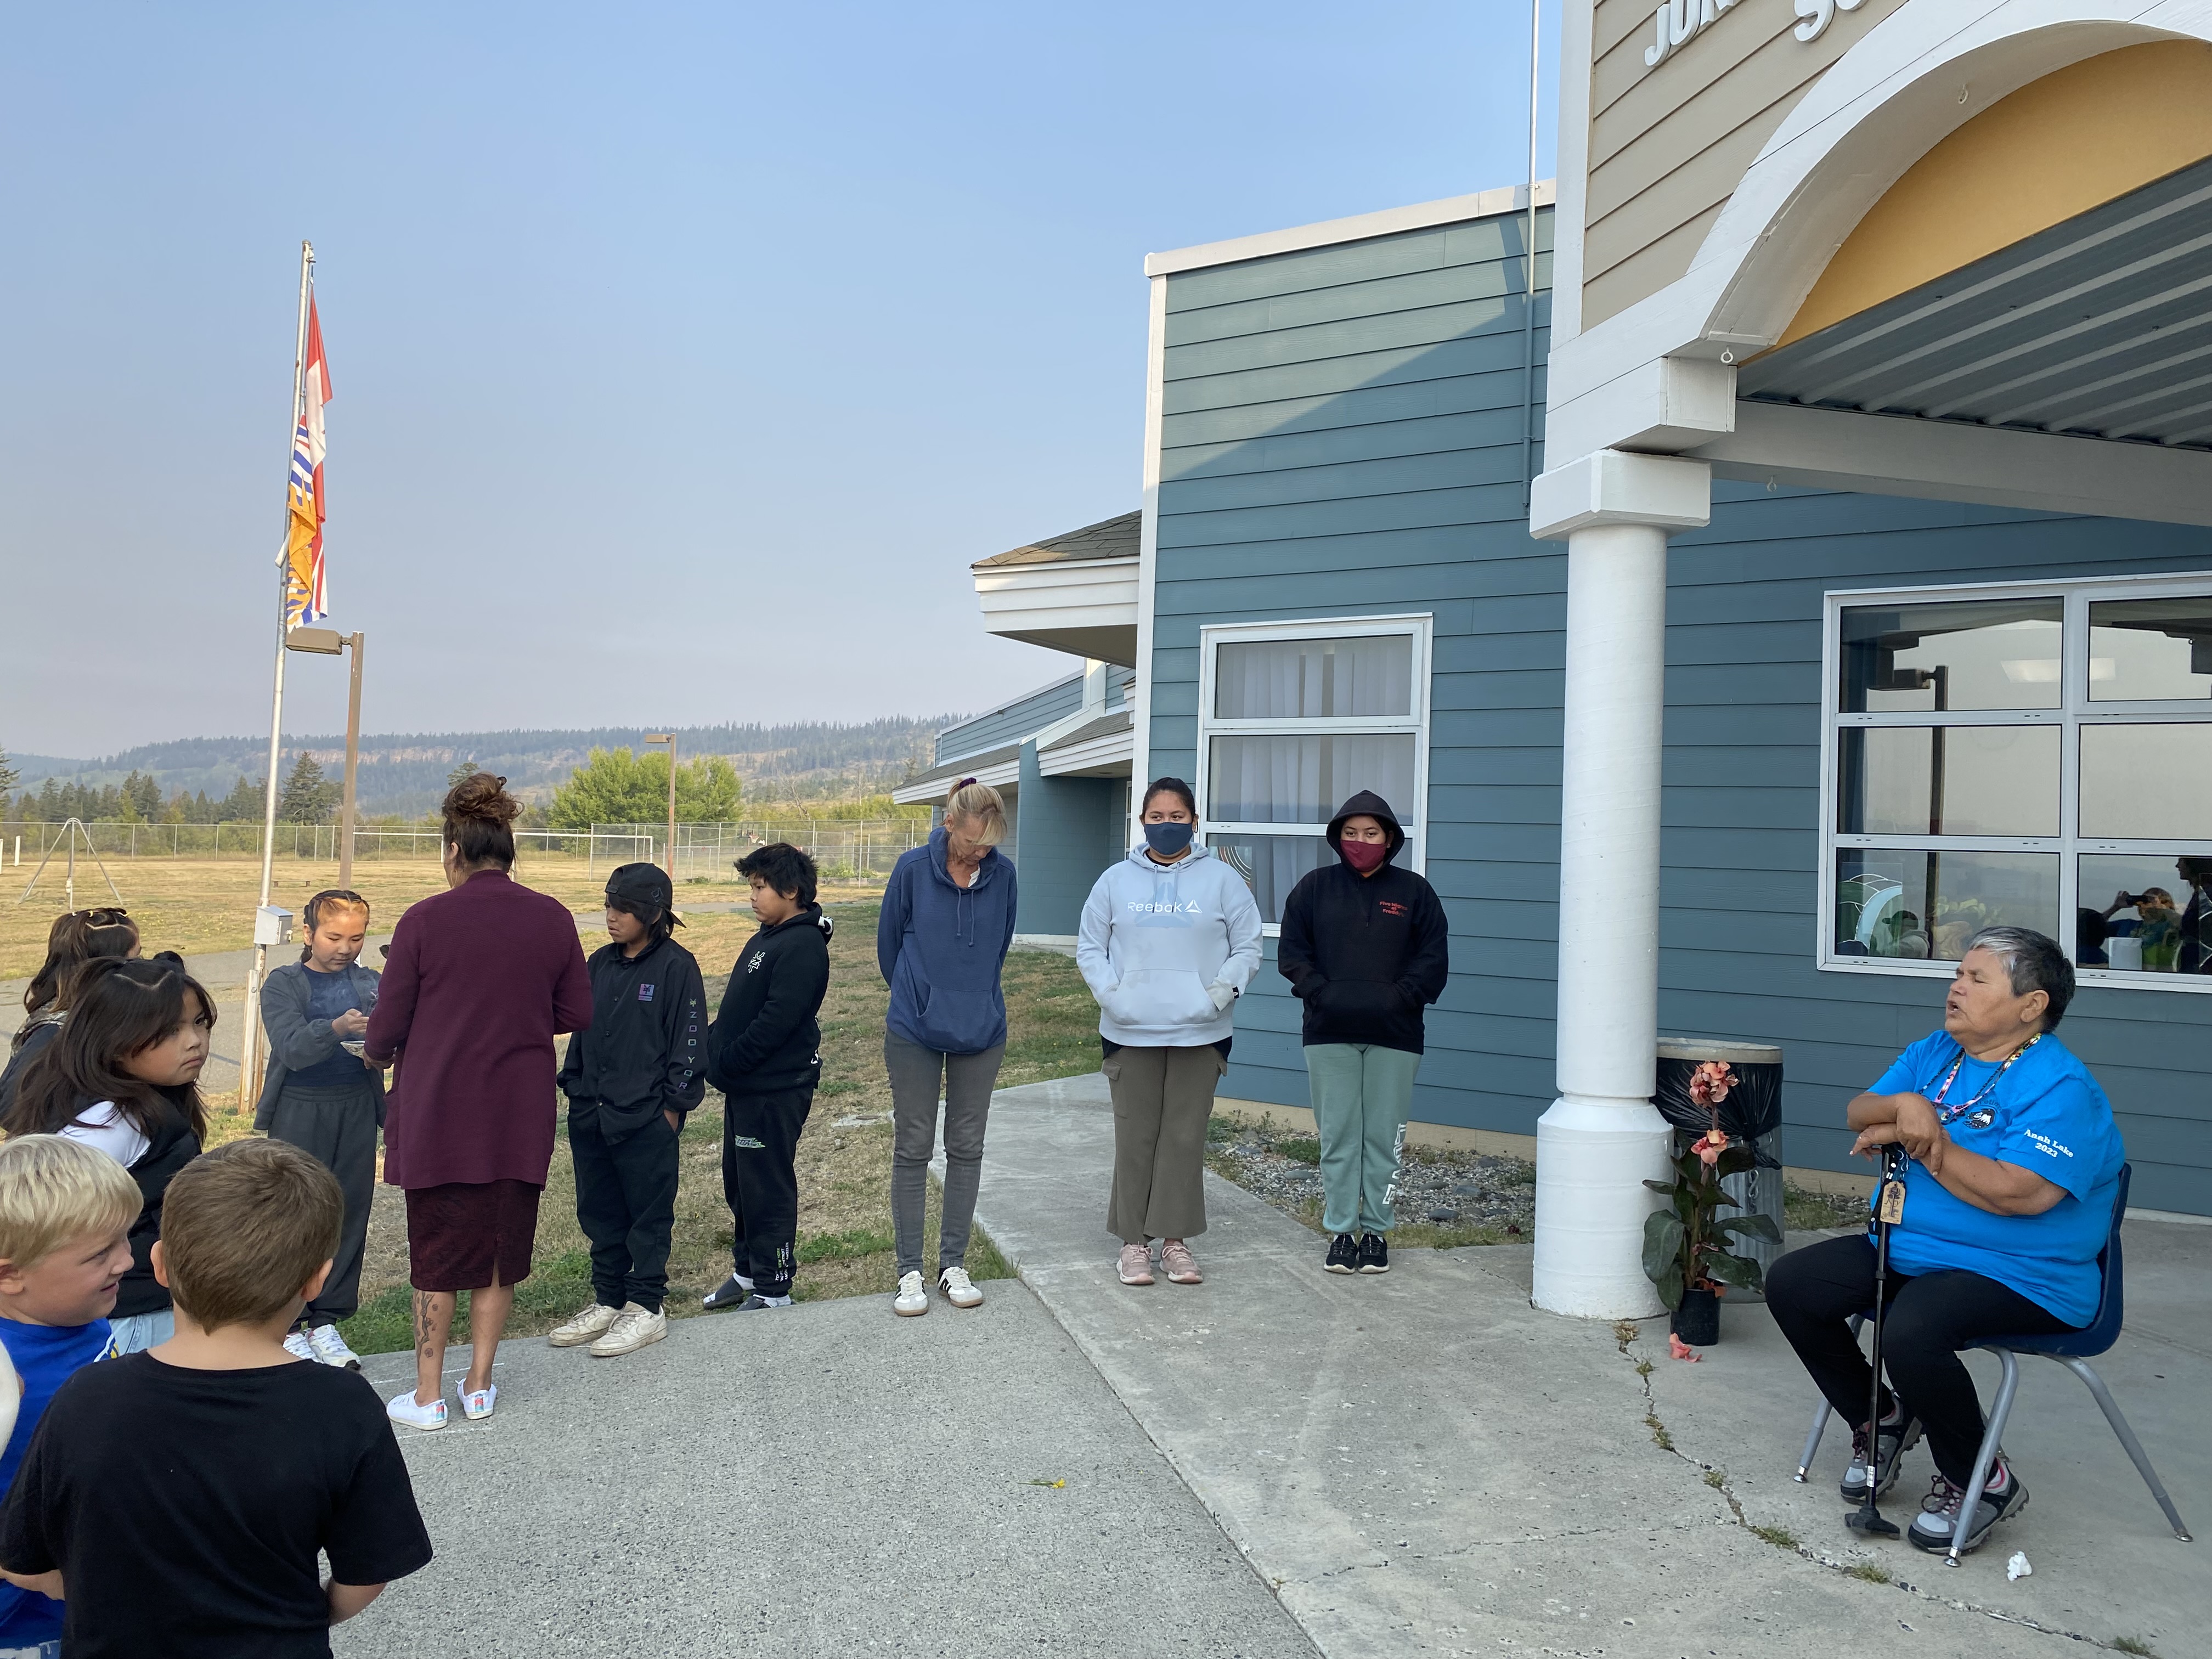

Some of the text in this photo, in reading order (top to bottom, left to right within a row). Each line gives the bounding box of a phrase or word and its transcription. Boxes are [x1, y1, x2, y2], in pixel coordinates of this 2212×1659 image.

[1127, 901, 1182, 912] Reebok
[2024, 1128, 2073, 1158] Anah Lake
[2035, 1142, 2058, 1158] 2023
